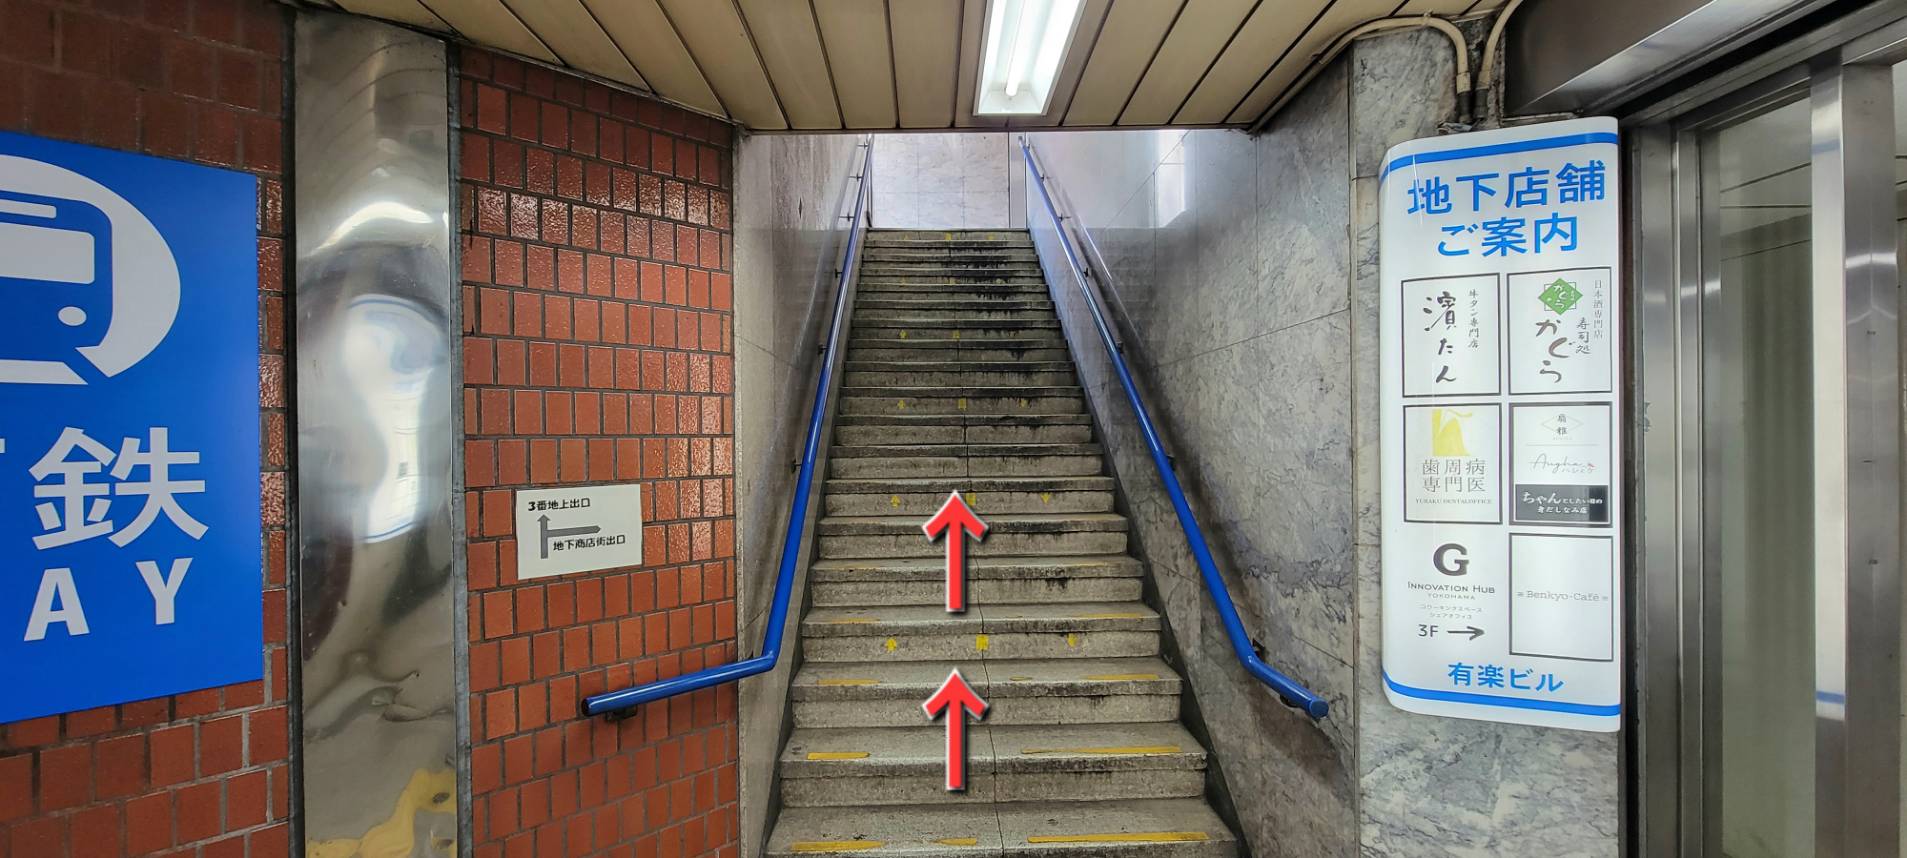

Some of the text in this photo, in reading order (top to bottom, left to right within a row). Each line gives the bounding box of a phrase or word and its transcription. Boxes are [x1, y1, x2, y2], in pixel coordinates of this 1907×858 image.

[1407, 159, 1606, 215] 地下店舗
[1437, 212, 1578, 257] ご案内
[1422, 290, 1457, 384] 濱たん
[1535, 318, 1577, 384] かぐら
[1575, 316, 1592, 354] 寿司処
[1422, 458, 1487, 476] 歯周病
[0, 426, 209, 551] 鉄
[1422, 476, 1487, 493] 専門医
[527, 497, 591, 512] 3番地上出口
[553, 534, 626, 551] 地下商店街出口
[1433, 543, 1470, 576] G
[1418, 623, 1439, 638] 3F
[1447, 662, 1565, 692] 有楽ビル
